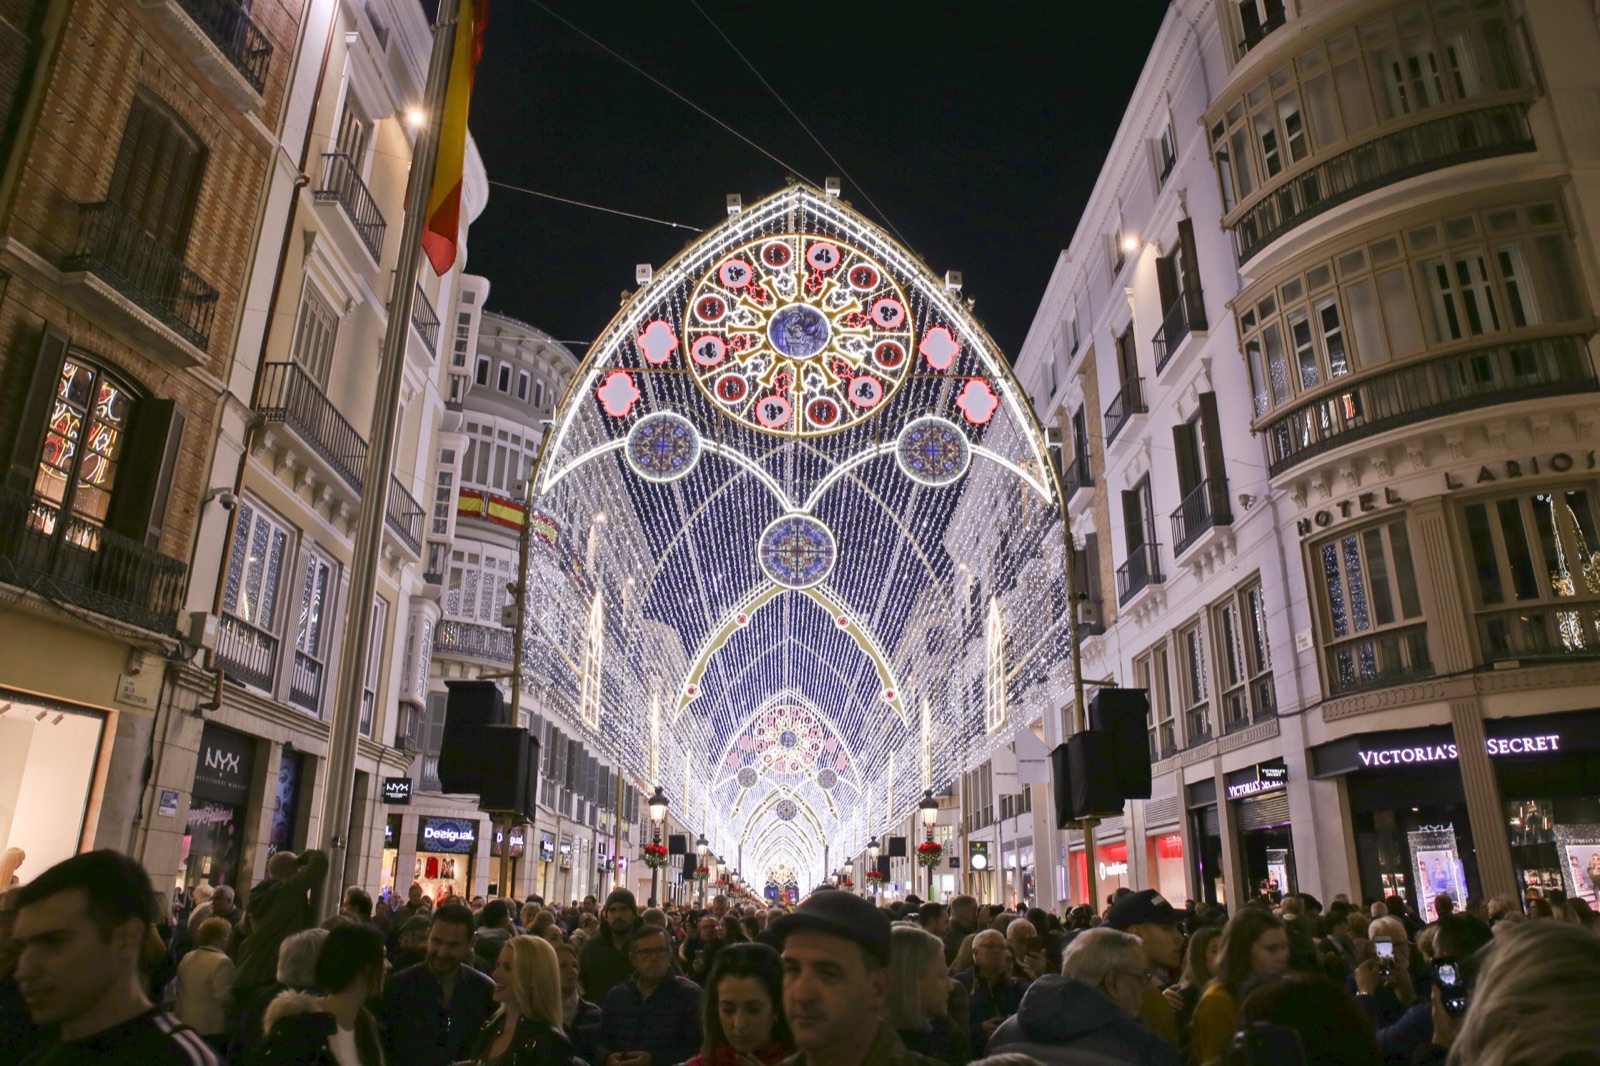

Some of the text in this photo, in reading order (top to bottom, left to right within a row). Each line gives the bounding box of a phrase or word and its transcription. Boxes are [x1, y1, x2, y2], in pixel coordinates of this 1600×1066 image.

[1297, 449, 1596, 537] HOTEL LARIOS
[205, 747, 240, 774] NYX
[1359, 735, 1559, 766] VICTORIA'S SECRET
[386, 783, 409, 791] NYX
